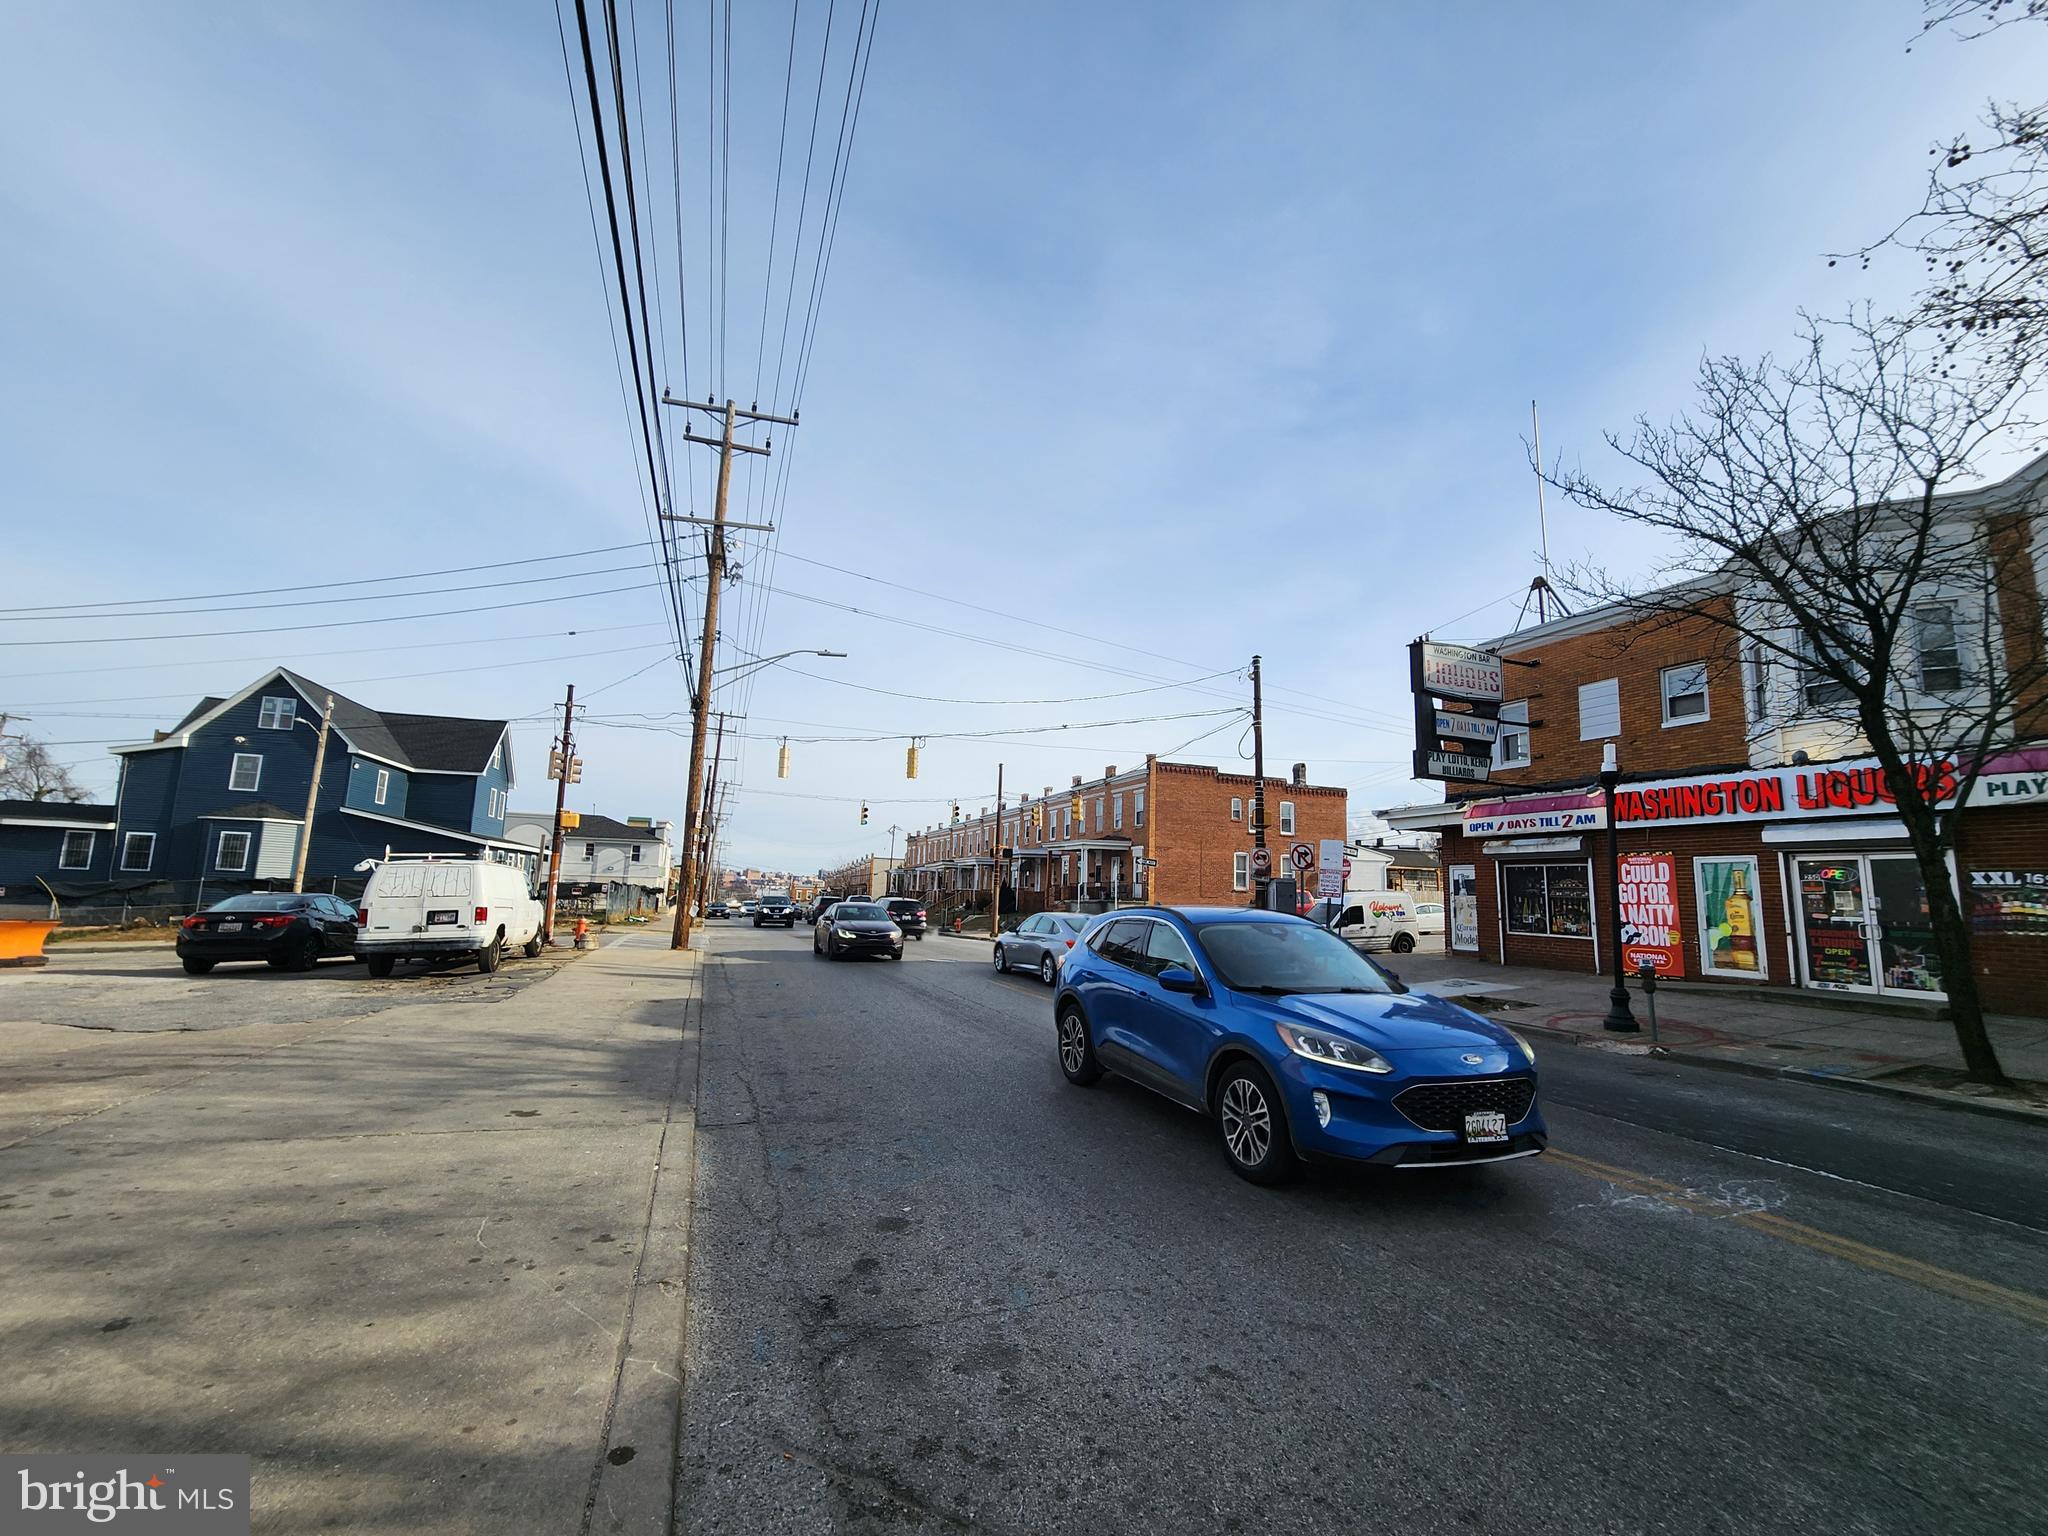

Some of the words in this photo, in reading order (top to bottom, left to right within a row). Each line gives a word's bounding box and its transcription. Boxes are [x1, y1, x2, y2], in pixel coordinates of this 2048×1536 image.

[1433, 645, 1477, 661] WASHINGTON
[1478, 653, 1491, 664] BAR
[1427, 659, 1500, 692] LIQUORS
[1436, 718, 1450, 729] OPEN
[1470, 722, 1480, 733] TILL
[1486, 725, 1495, 735] AM
[1428, 751, 1446, 763] PLAY
[1470, 757, 1488, 769] KENO
[1442, 765, 1476, 778] BILLIARDS
[1987, 778, 2047, 797] PLAY
[1614, 776, 1785, 822] WASHINGTON
[1469, 821, 1494, 832] OPEN
[1507, 818, 1537, 829] DAYS
[1539, 817, 1561, 827] TILL
[1562, 814, 1574, 829] 2
[1575, 814, 1596, 825] AM
[1621, 862, 1670, 883] COULD
[1970, 871, 2022, 885] XXL
[1618, 883, 1638, 904] GO
[1639, 883, 1670, 905] FOR
[1627, 904, 1675, 926] NATTY
[1638, 925, 1671, 947] BOH
[1630, 952, 1668, 961] NATIONAL
[1824, 948, 1851, 956] OPEN
